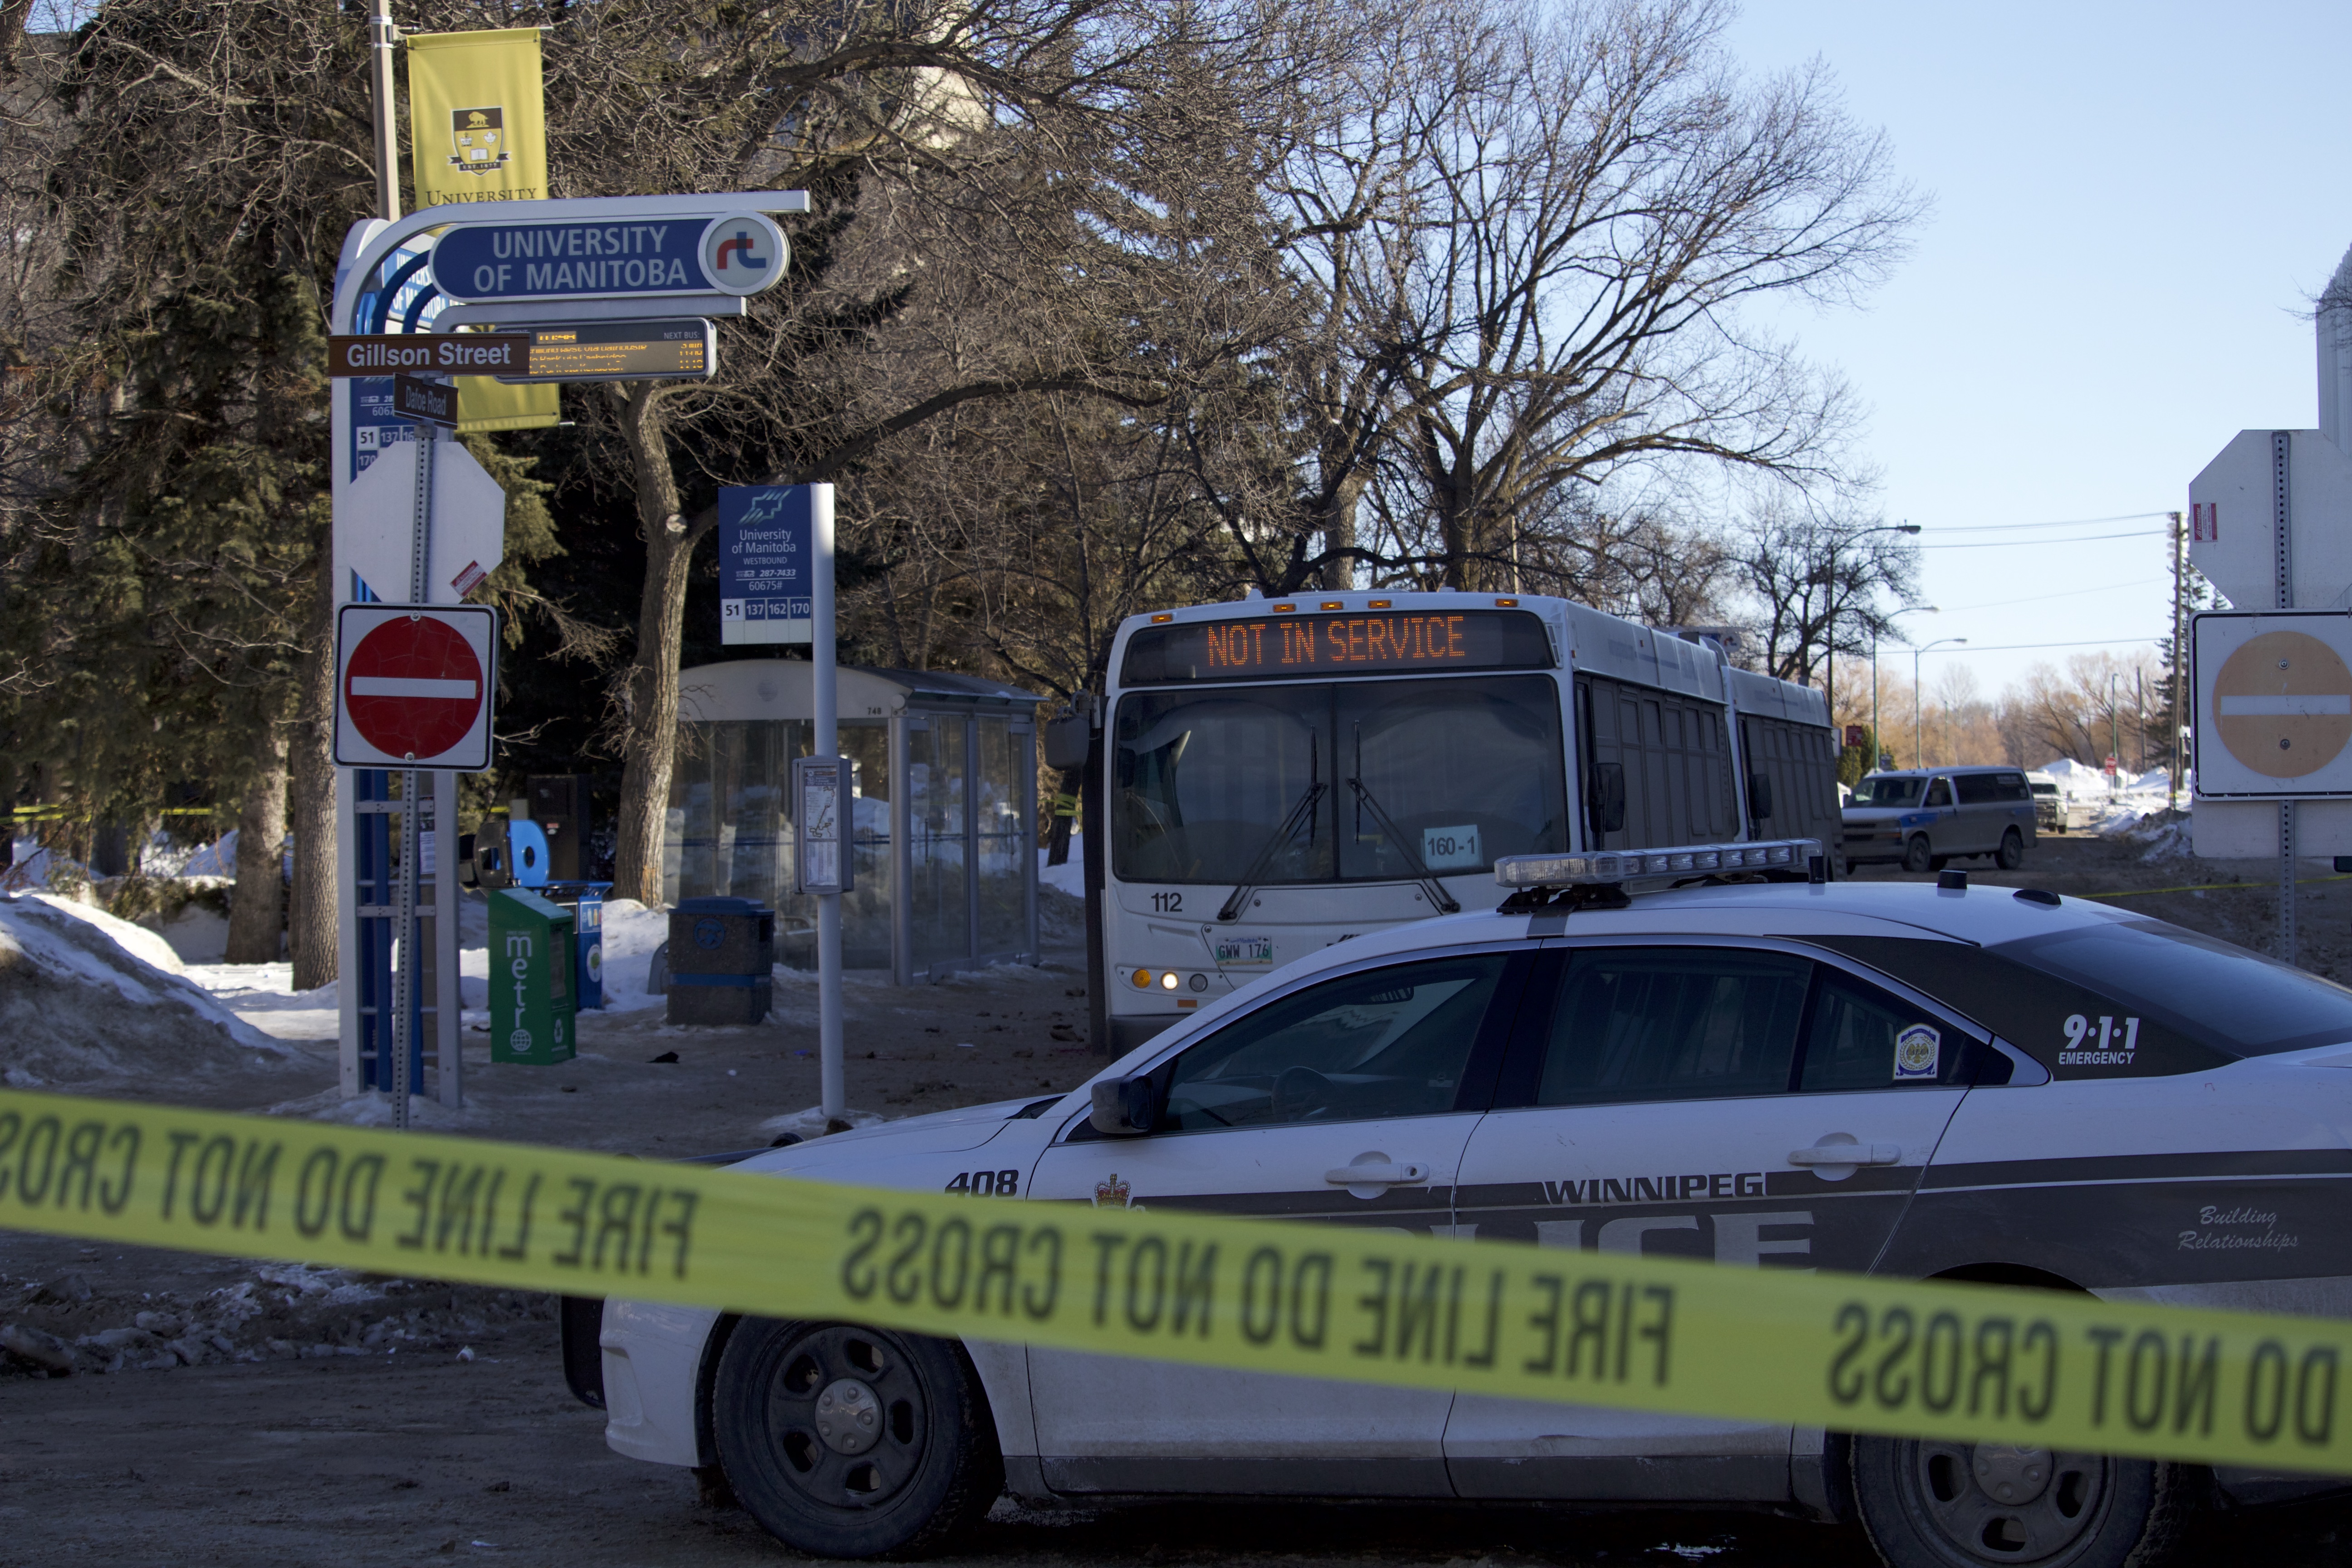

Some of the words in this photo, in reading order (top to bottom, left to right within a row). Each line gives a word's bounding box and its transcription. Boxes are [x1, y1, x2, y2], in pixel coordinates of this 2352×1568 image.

[426, 188, 537, 206] UNIVERSITY
[493, 225, 668, 259] UNIVERSITY
[474, 265, 512, 292] OF
[526, 258, 688, 290] MANITOBA
[347, 343, 430, 367] Gillson
[438, 342, 510, 364] Street
[406, 384, 426, 412] Dafoe
[427, 390, 447, 416] Road
[360, 431, 373, 444] 51
[381, 431, 398, 442] 137
[740, 528, 791, 541] University
[732, 542, 743, 554] of
[746, 541, 796, 554] Manitoba
[743, 556, 787, 565] WESTBOUND
[759, 569, 796, 577] 287-7433
[749, 581, 783, 591] 60675#
[726, 604, 739, 616] 51
[746, 604, 764, 615] 137
[769, 603, 786, 615] 162
[791, 603, 809, 614] 170
[1208, 623, 1266, 666] NOT
[1279, 622, 1315, 664] IN
[1327, 616, 1466, 662] SERVICE
[1151, 892, 1182, 912] 112
[1219, 945, 1240, 958] GWW
[1249, 944, 1269, 958] 176
[2058, 1051, 2135, 1065] EMERGENCY
[944, 1169, 1019, 1198] 408
[1544, 1171, 1764, 1206] WINNIPEG
[2199, 1205, 2278, 1230] Building
[2178, 1230, 2299, 1252] Relationships
